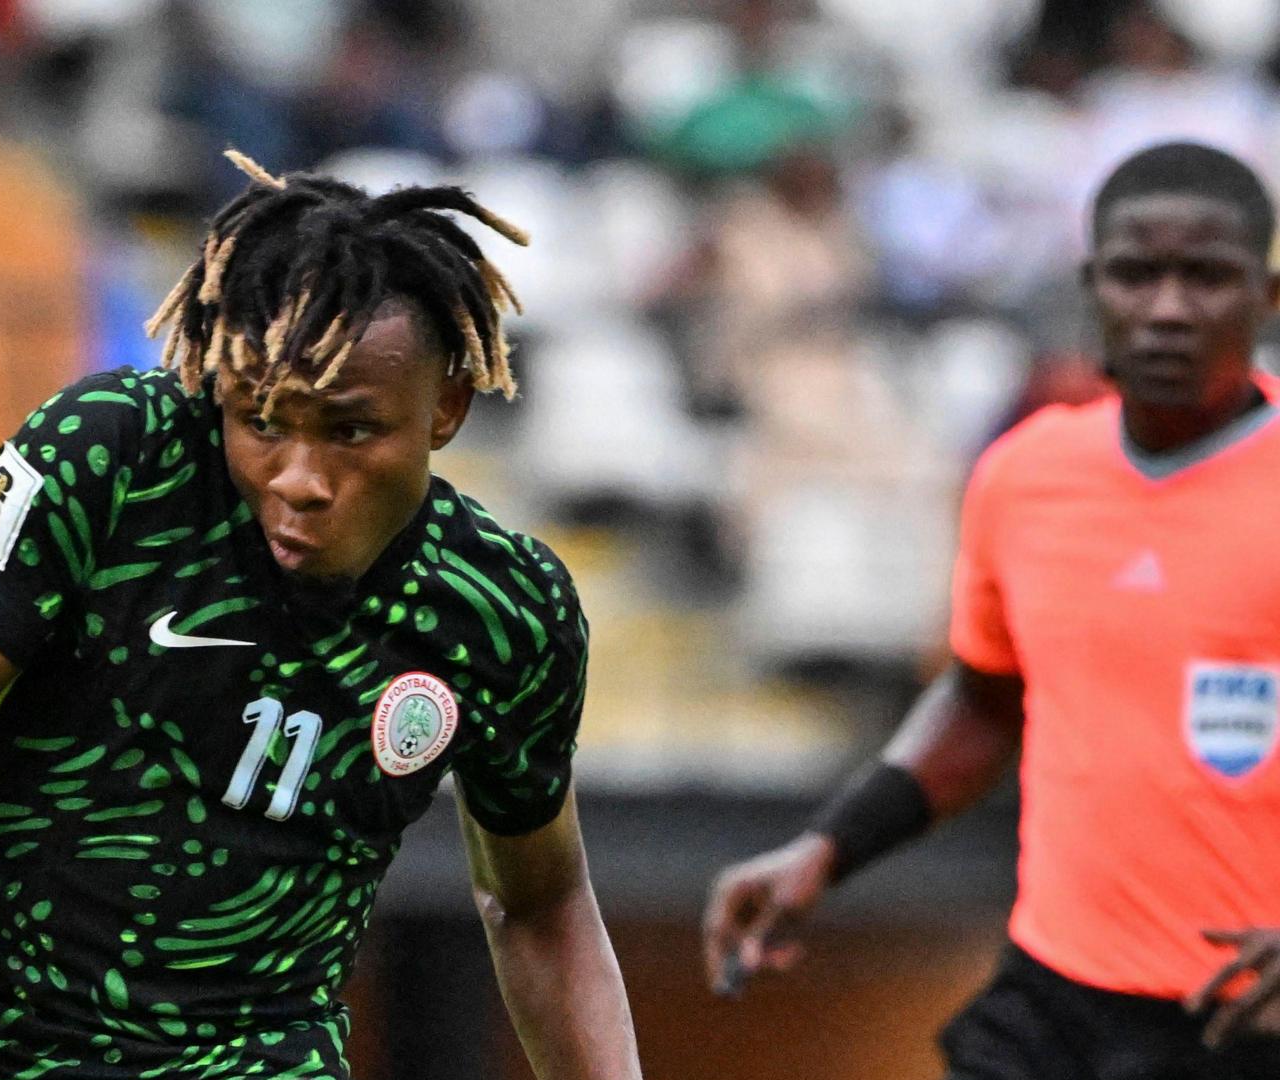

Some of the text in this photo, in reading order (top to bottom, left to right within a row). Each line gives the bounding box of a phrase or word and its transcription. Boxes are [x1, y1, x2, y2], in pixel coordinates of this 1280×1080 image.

[221, 696, 323, 822] 11
[377, 678, 454, 762] NIGERIA FOOTBALL FEDERATION
